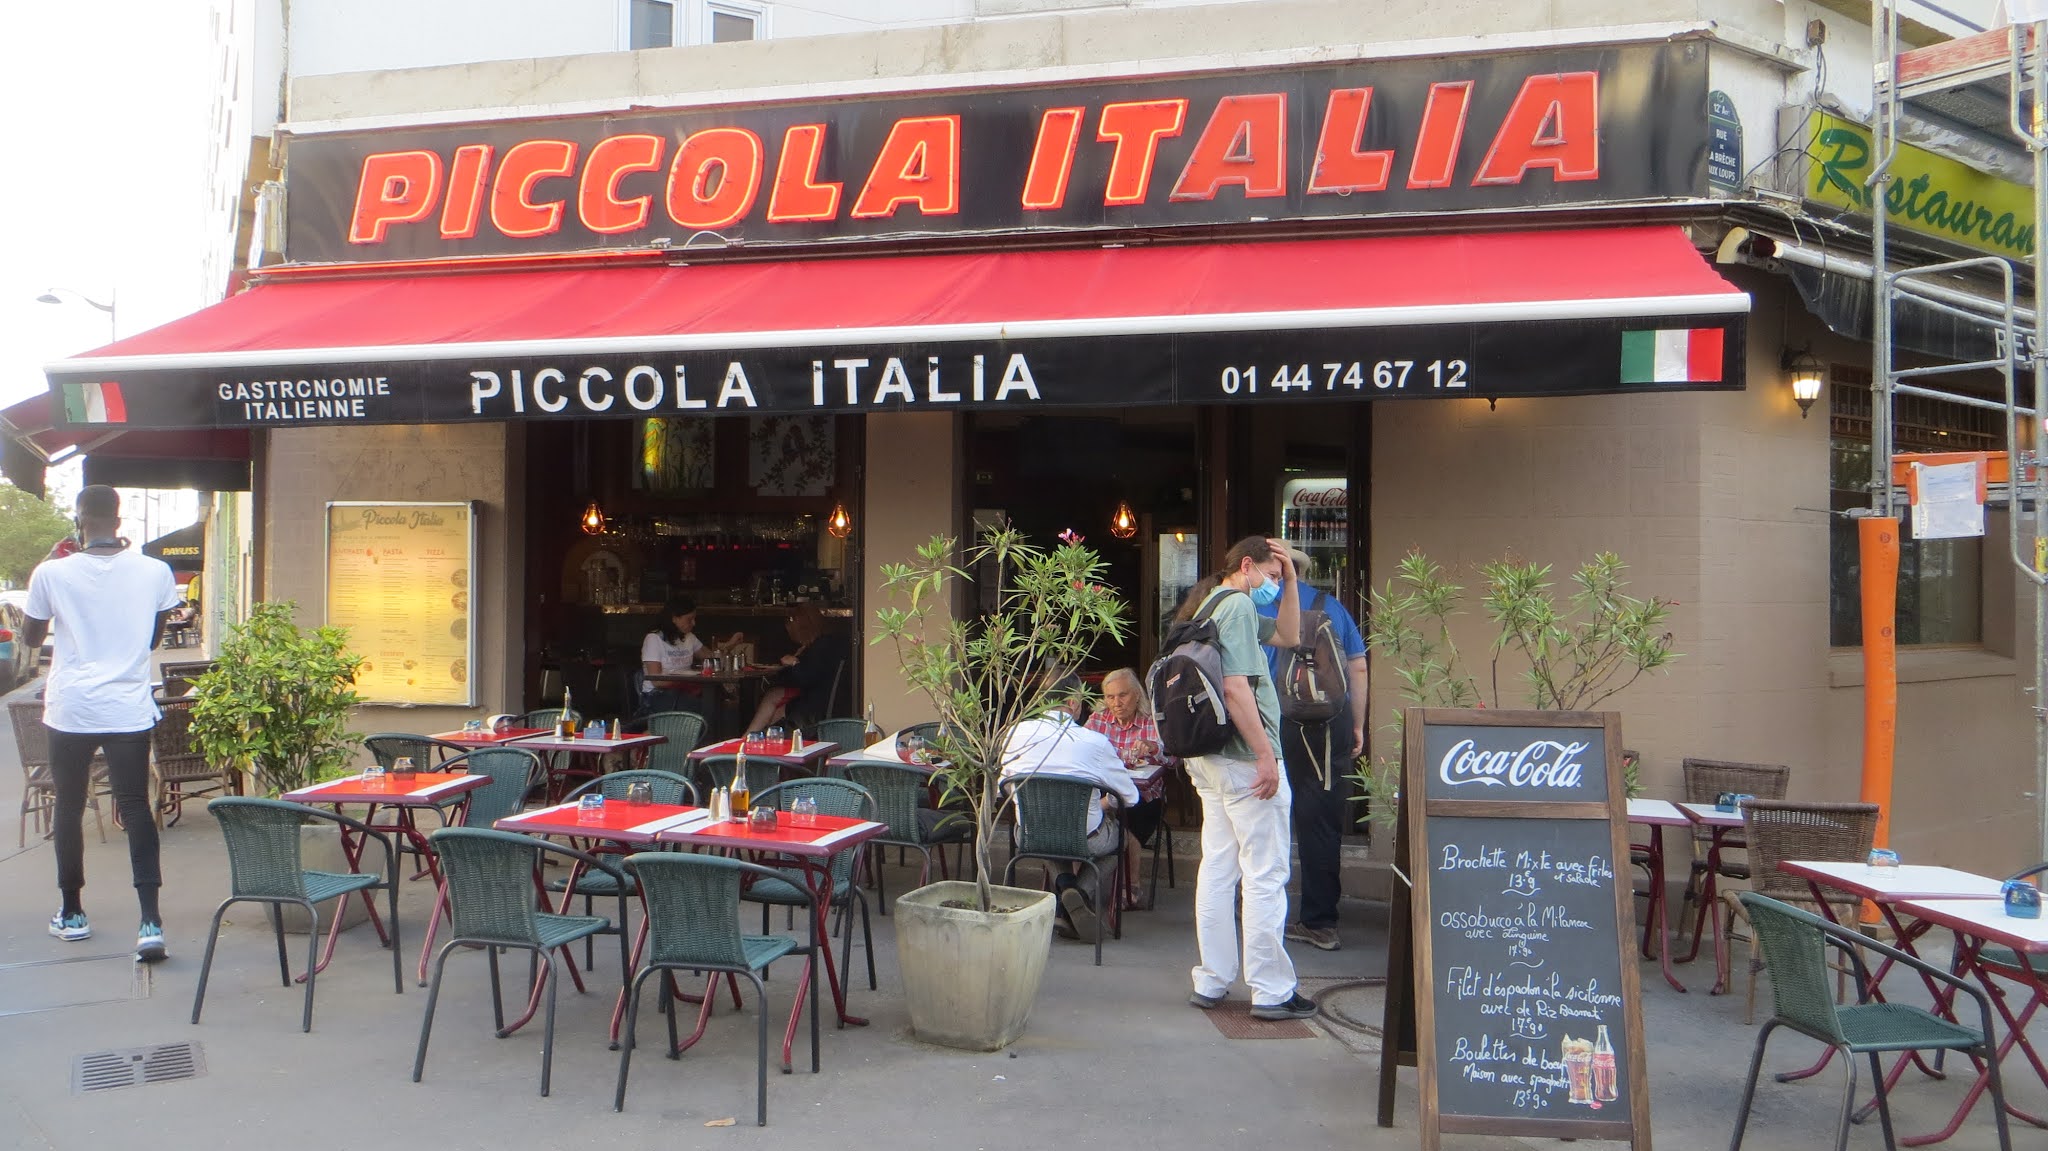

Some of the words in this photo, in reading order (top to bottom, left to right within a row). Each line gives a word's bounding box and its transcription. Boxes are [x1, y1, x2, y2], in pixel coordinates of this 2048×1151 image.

[1716, 128, 1727, 141] RUE
[348, 115, 960, 244] PICCOLA
[1022, 72, 1598, 210] ITALIA
[1719, 167, 1736, 181] LOUPS
[470, 361, 758, 414] PICCOLA
[811, 353, 1041, 406] ITALIA
[1221, 366, 1256, 394] 01
[1271, 364, 1312, 392] 44
[1323, 362, 1364, 391] 74
[1374, 360, 1414, 389] 67
[1427, 359, 1467, 388] 12
[244, 399, 366, 420] ITALIENNE
[362, 509, 406, 529] Piccola
[162, 546, 199, 556] PAYUSS
[1440, 739, 1590, 788] Coca-Cola
[1438, 844, 1507, 871] Brochette
[1556, 861, 1586, 873] avec
[1465, 928, 1493, 939] avec
[1447, 966, 1481, 1001] Filet
[1516, 999, 1531, 1016] de
[1536, 1000, 1557, 1018] Riz
[1449, 1033, 1516, 1062] Boulettes
[1522, 1046, 1538, 1066] de
[1463, 1062, 1495, 1083] Maison
[1500, 1073, 1525, 1085] avec
